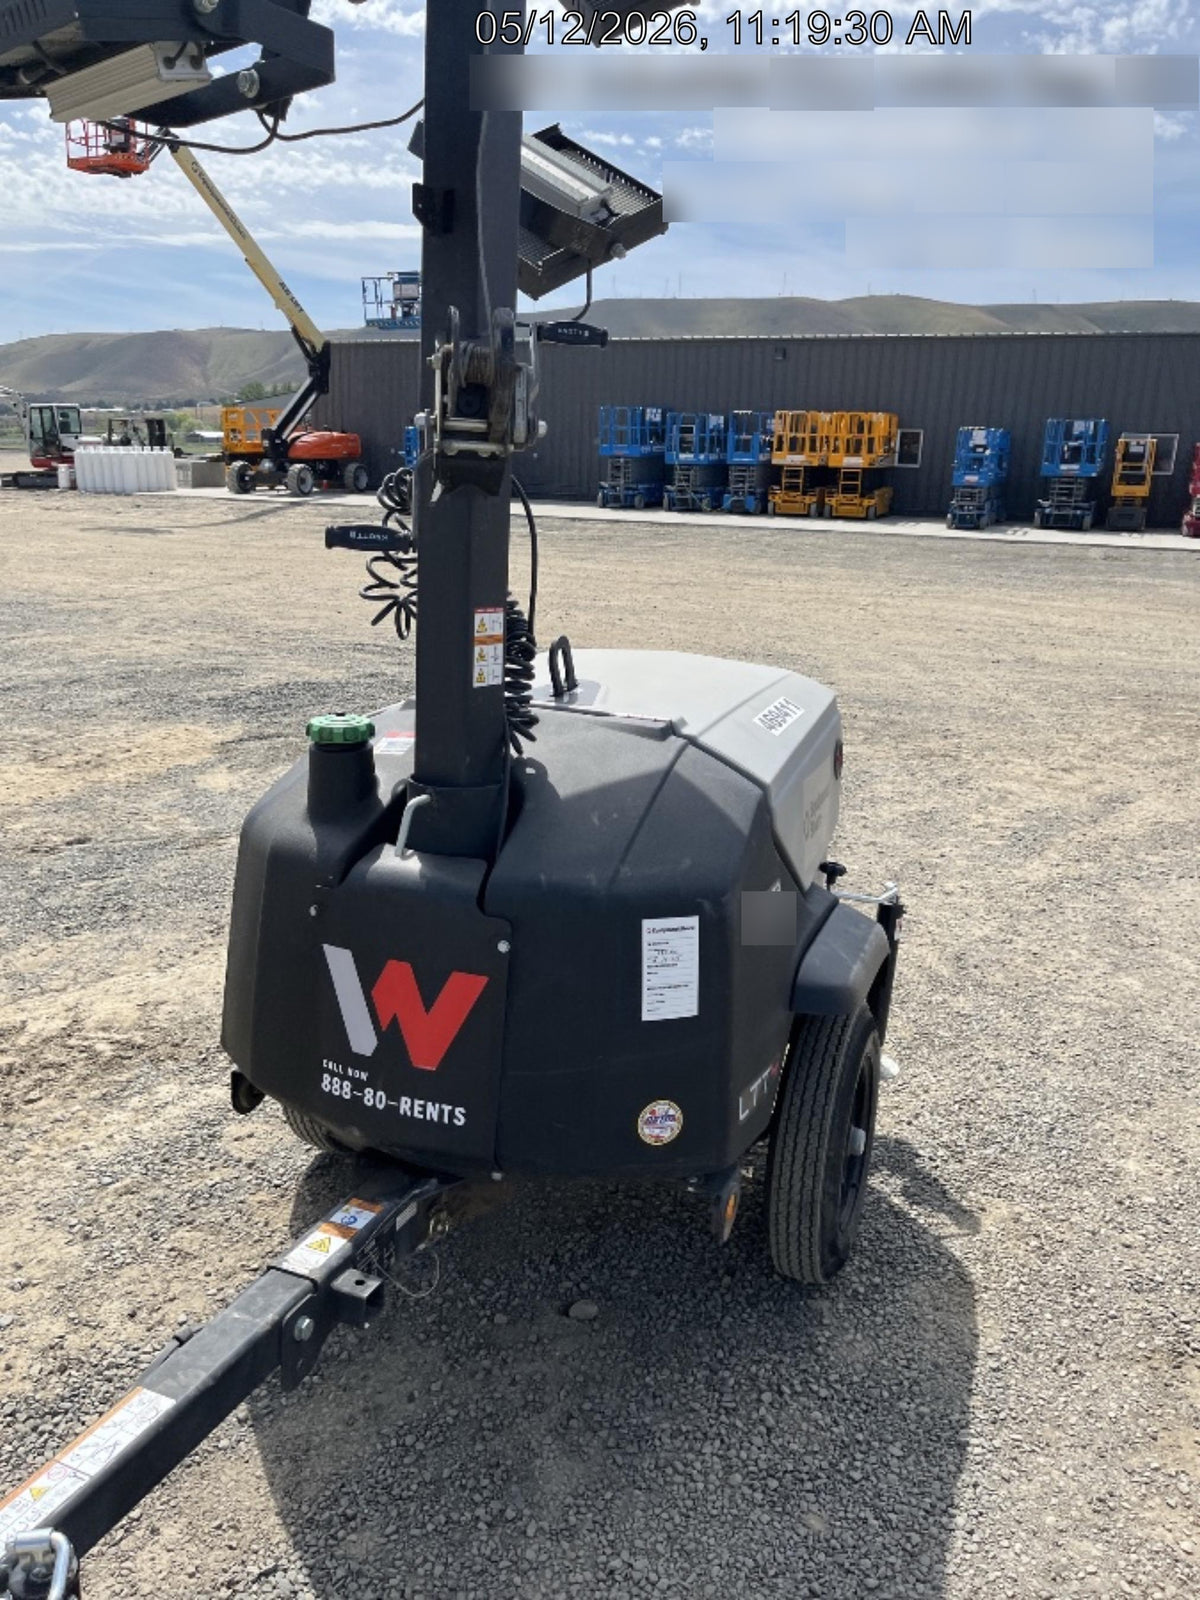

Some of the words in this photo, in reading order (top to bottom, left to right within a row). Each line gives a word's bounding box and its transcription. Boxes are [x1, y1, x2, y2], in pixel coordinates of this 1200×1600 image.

[322, 1059, 344, 1075] CALL
[347, 1067, 369, 1082] NOW
[321, 1073, 467, 1127] 888-80-RENTS
